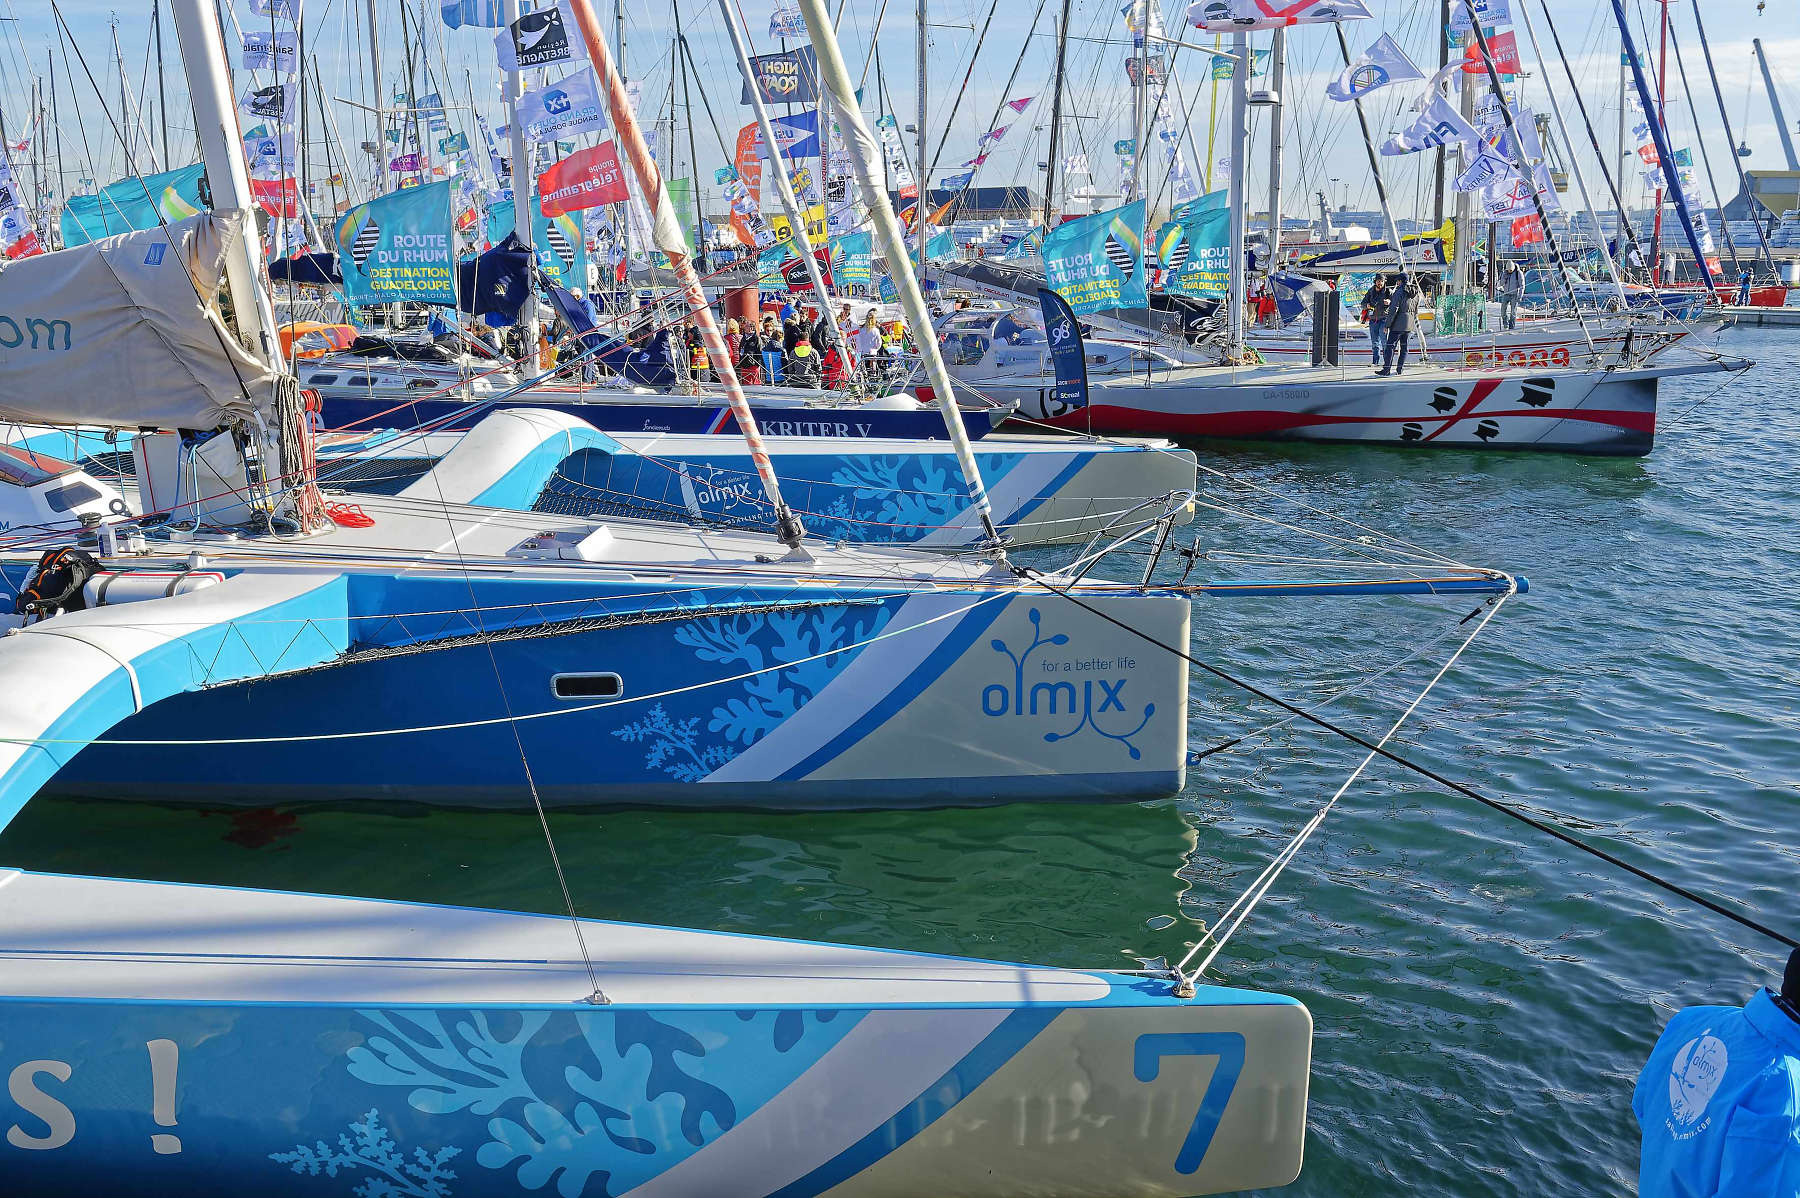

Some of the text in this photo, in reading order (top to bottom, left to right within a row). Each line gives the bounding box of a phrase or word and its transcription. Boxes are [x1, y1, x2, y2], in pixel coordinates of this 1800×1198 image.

[393, 234, 447, 248] ROUTE
[377, 249, 448, 263] DU RHUM
[1201, 247, 1231, 259] ROUT
[370, 267, 449, 278] DESTINATION
[1187, 261, 1231, 272] DU RHU
[1180, 273, 1231, 283] DESTINATIO
[370, 281, 451, 291] GUADELOUPE
[1182, 283, 1231, 292] GUADELOU
[761, 421, 872, 438] KRITER V
[1042, 656, 1136, 672] for a better life
[1134, 1031, 1246, 1175] 7
